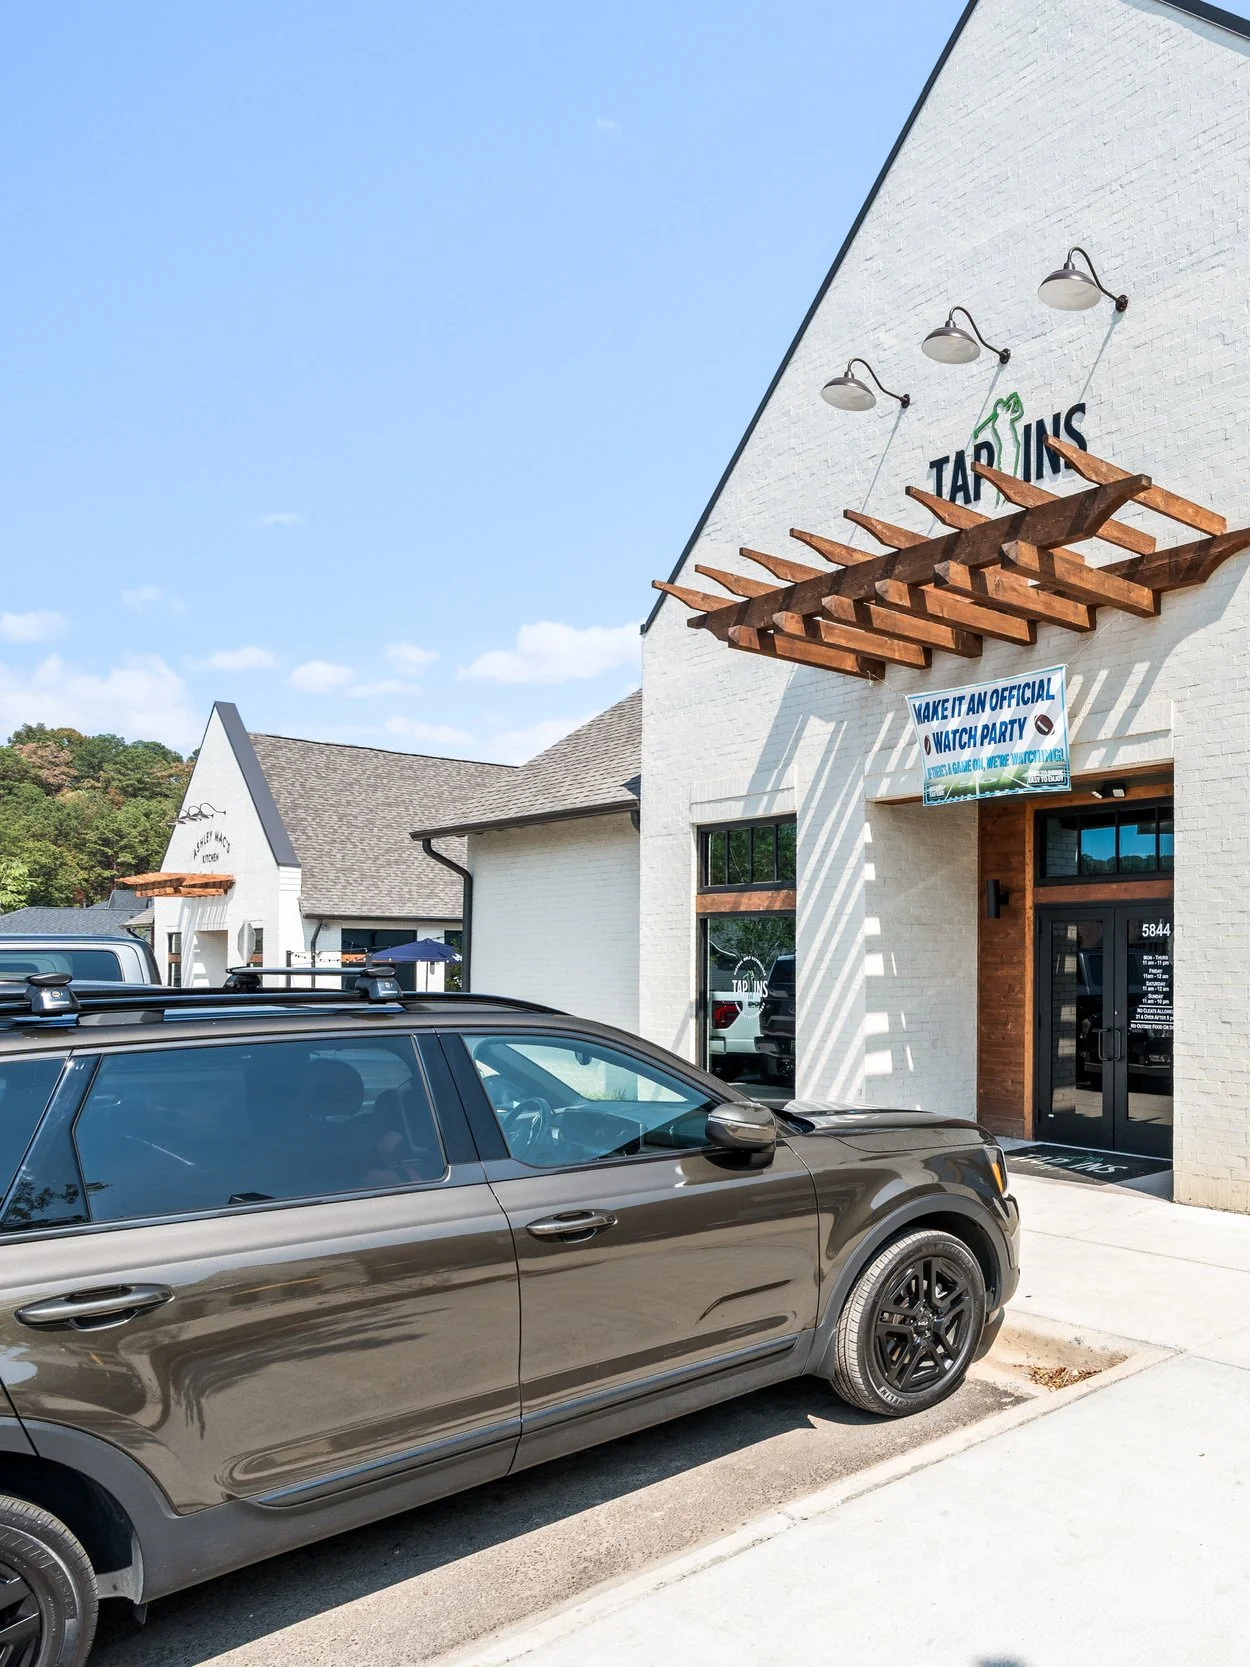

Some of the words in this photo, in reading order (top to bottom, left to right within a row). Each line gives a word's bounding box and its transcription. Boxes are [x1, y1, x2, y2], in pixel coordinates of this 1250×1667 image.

[929, 440, 995, 505] TAP
[1023, 402, 1088, 482] INS
[951, 695, 965, 718] IT
[966, 691, 987, 716] AN
[990, 678, 1055, 712] OFFICIAL
[932, 725, 977, 754] WATCH
[980, 717, 1028, 747] PARTY
[987, 753, 1009, 769] WE'RE
[1011, 748, 1064, 766] WATCHING!
[193, 830, 213, 860] ASHLEY
[1142, 923, 1171, 937] 5844
[732, 980, 747, 997] TAP
[754, 980, 768, 998] INS
